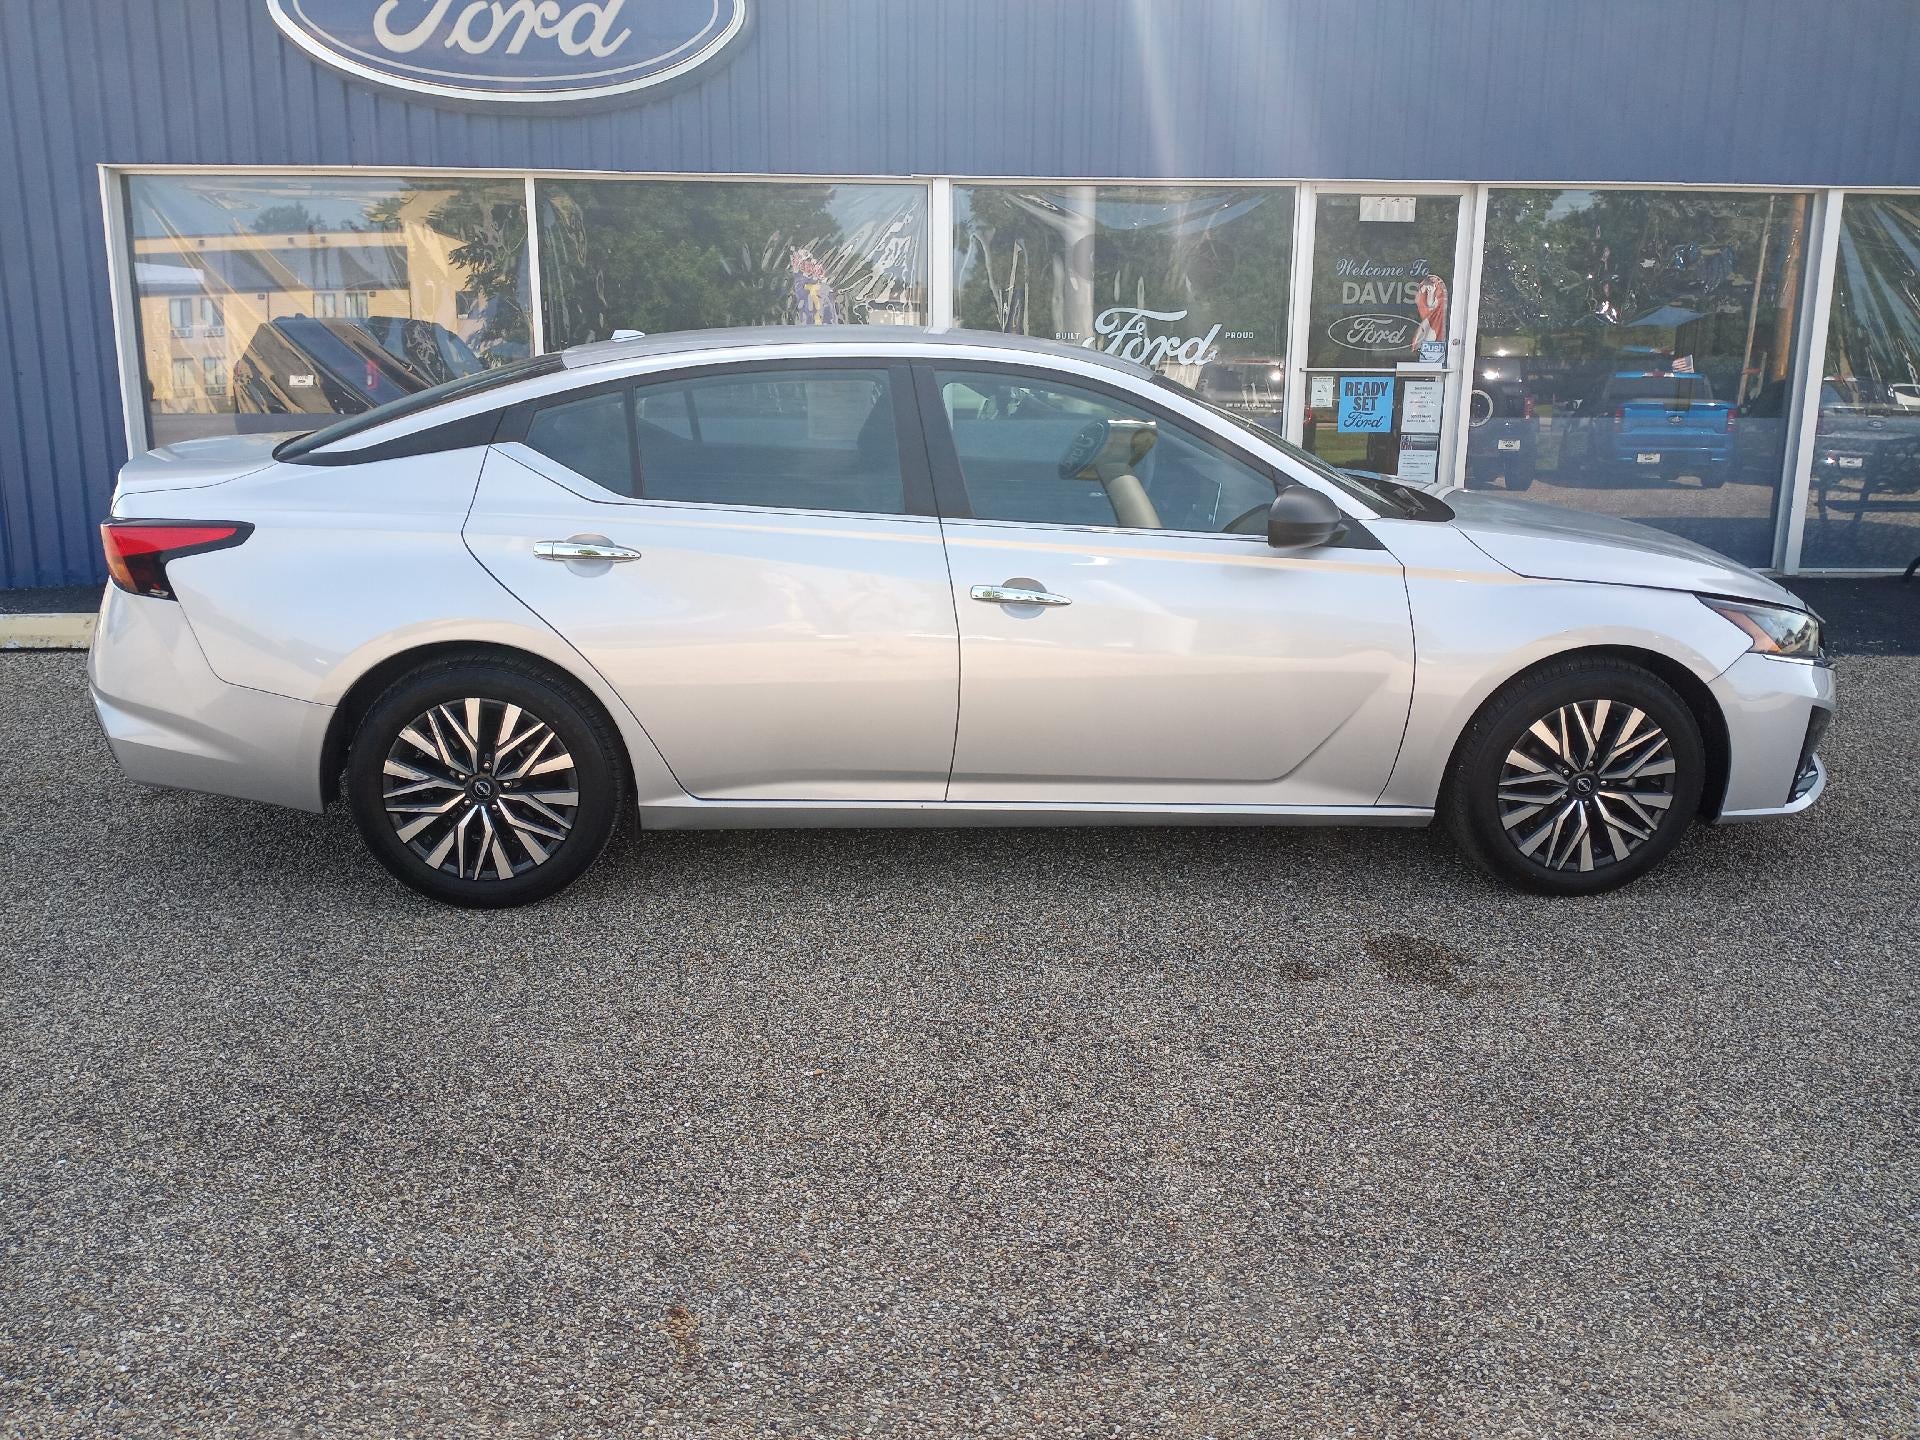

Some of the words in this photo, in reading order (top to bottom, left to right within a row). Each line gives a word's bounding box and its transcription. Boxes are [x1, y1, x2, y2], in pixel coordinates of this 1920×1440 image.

[1336, 258, 1404, 276] Welcome
[1410, 258, 1430, 276] To
[1342, 281, 1420, 305] DAVIS
[1055, 332, 1081, 340] BUILT
[1081, 307, 1223, 366] Ford
[1225, 331, 1254, 340] PROUD
[1346, 317, 1408, 344] Ford
[1421, 342, 1445, 353] Push
[1344, 381, 1389, 397] READY
[1352, 396, 1379, 412] SET
[1343, 411, 1384, 428] Ford
